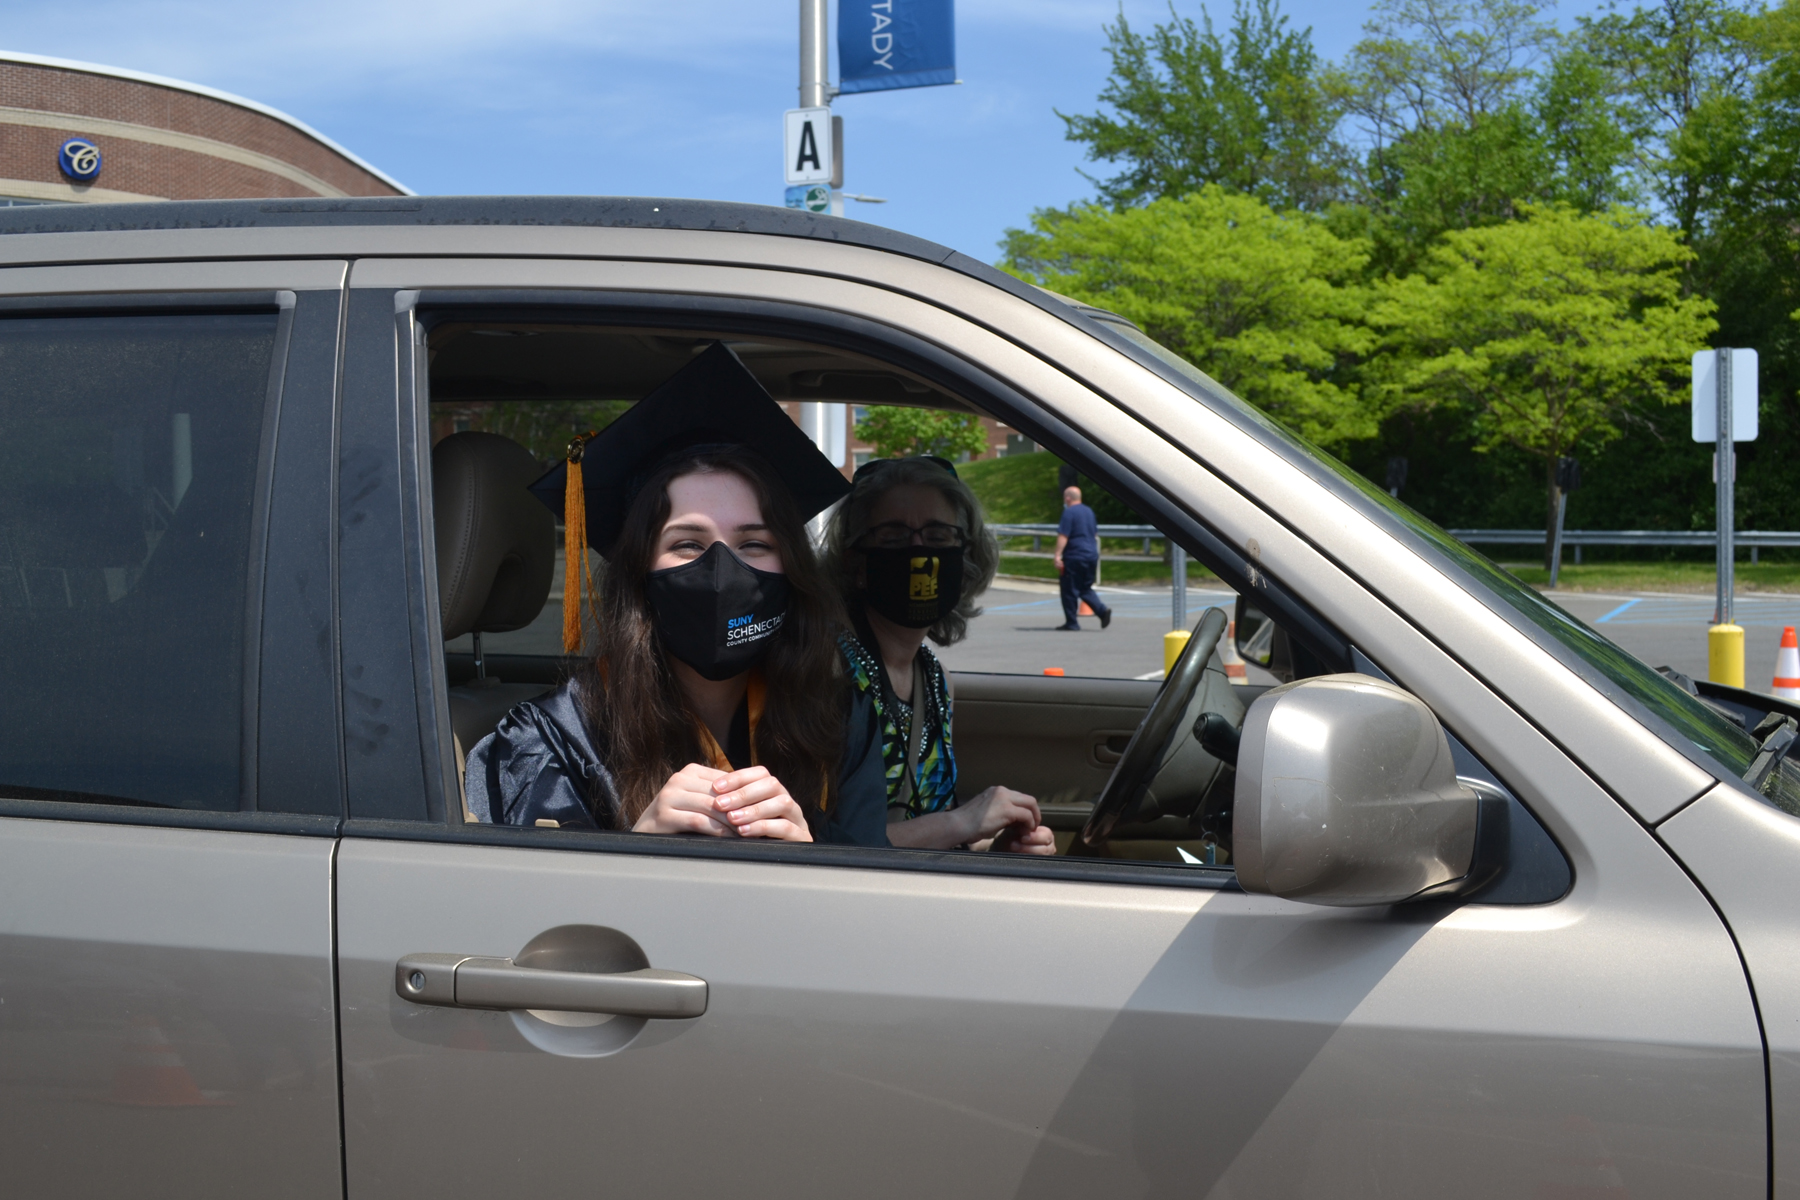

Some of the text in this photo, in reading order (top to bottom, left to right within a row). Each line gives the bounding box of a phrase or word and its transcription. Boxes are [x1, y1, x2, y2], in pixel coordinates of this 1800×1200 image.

[871, 0, 894, 70] TADY
[795, 121, 821, 172] A
[909, 581, 938, 597] PEF
[727, 613, 754, 629] SUNY
[726, 629, 775, 647] COUNTY COMMUNITY
